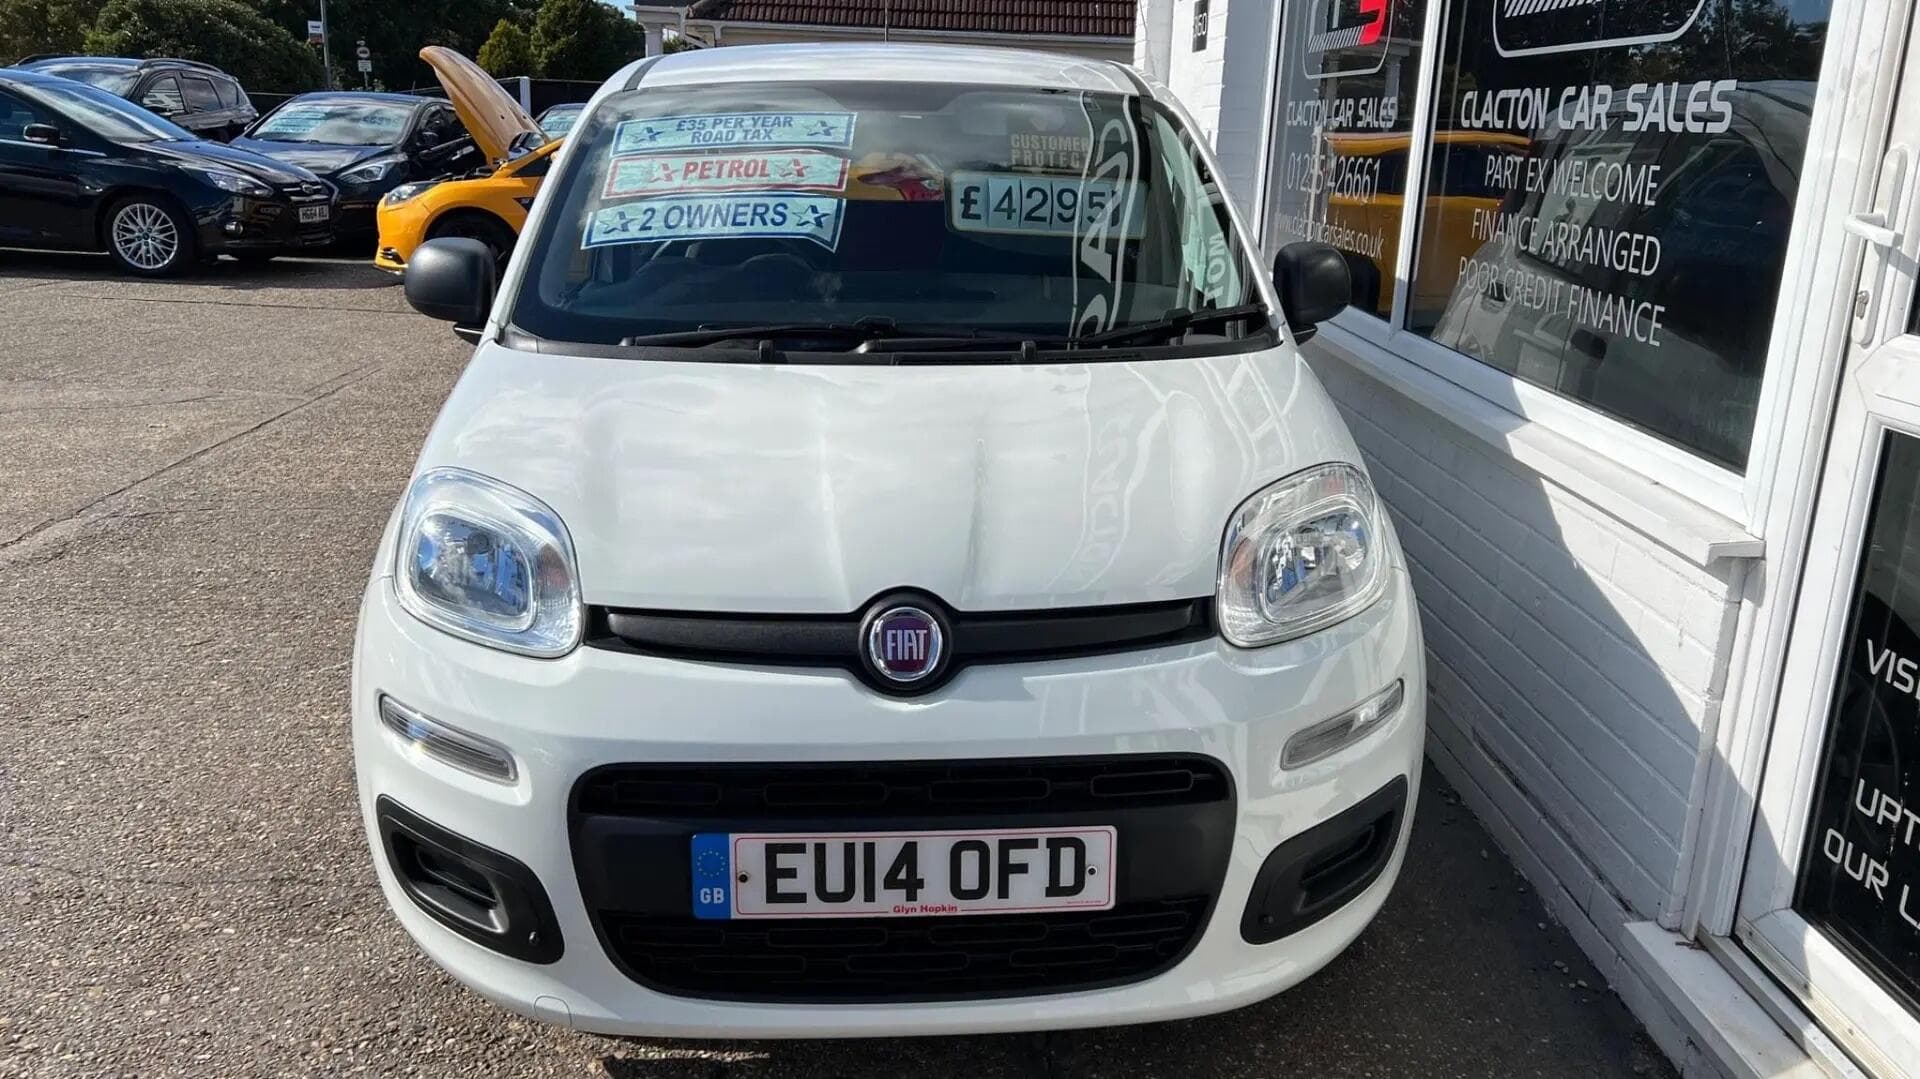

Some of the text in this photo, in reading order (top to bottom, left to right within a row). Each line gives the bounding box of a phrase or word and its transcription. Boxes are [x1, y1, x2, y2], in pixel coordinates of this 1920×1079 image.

[676, 116, 793, 132] £35 PER YEAR
[1286, 96, 1398, 129] CLACTON CAR SALES
[1460, 79, 1738, 134] CLACTON CAR SALES
[691, 128, 774, 144] ROAD TAX
[1011, 134, 1089, 152] CUSTOMER
[682, 158, 771, 181] PETROL
[1326, 155, 1381, 204] 426661
[1484, 154, 1661, 207] PART EX WELCOME
[639, 202, 789, 232] 2 OWNERS
[1471, 207, 1661, 277] FINANCE ARRANGED
[1457, 256, 1666, 348] POOR CREDIT FINANCE
[886, 629, 928, 661] FIAT
[1867, 638, 1920, 699] VIS
[1855, 777, 1920, 848] UPT
[764, 836, 1087, 905] EU14 OFD
[1823, 827, 1889, 901] OUR
[699, 888, 725, 904] GB
[893, 904, 958, 914] Glyn Hopkin
